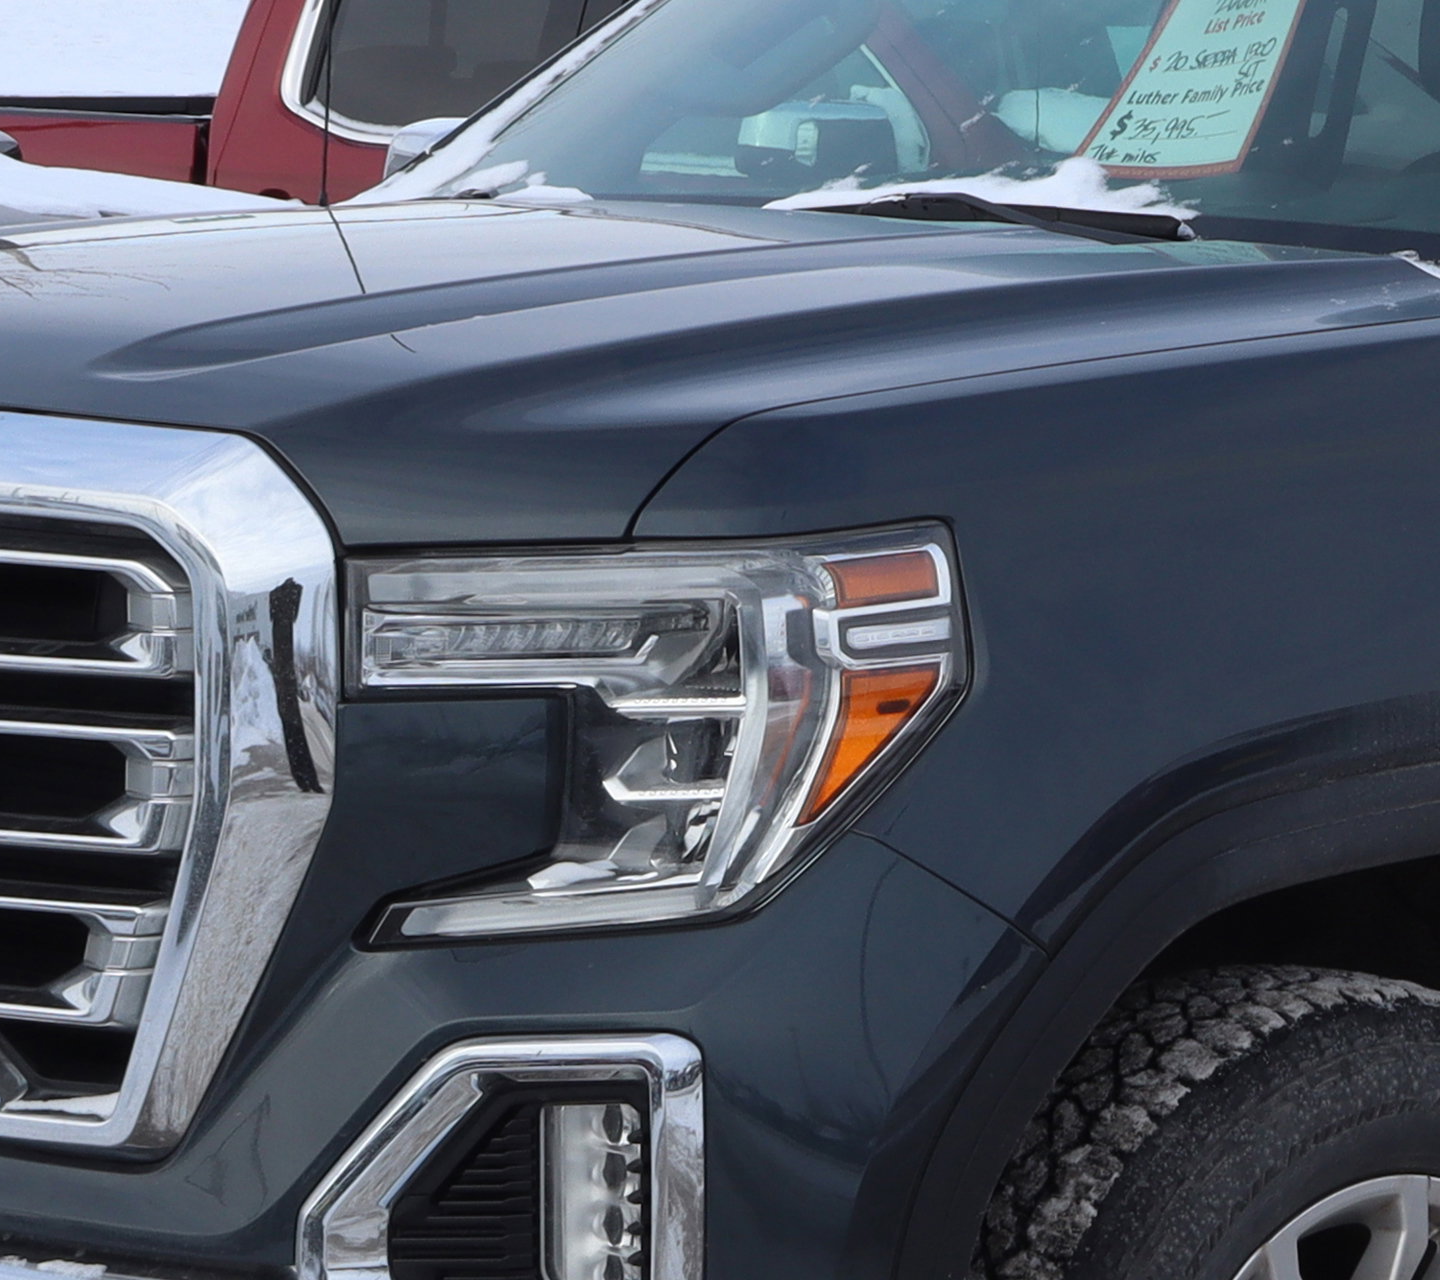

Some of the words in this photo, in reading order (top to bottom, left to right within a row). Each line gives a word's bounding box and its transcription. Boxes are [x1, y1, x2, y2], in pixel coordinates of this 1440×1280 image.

[1204, 18, 1231, 34] List
[1232, 10, 1266, 31] Price
[1127, 90, 1180, 105] Luther
[1181, 85, 1229, 105] Family
[1230, 79, 1266, 98] Price
[1110, 110, 1134, 141] $
